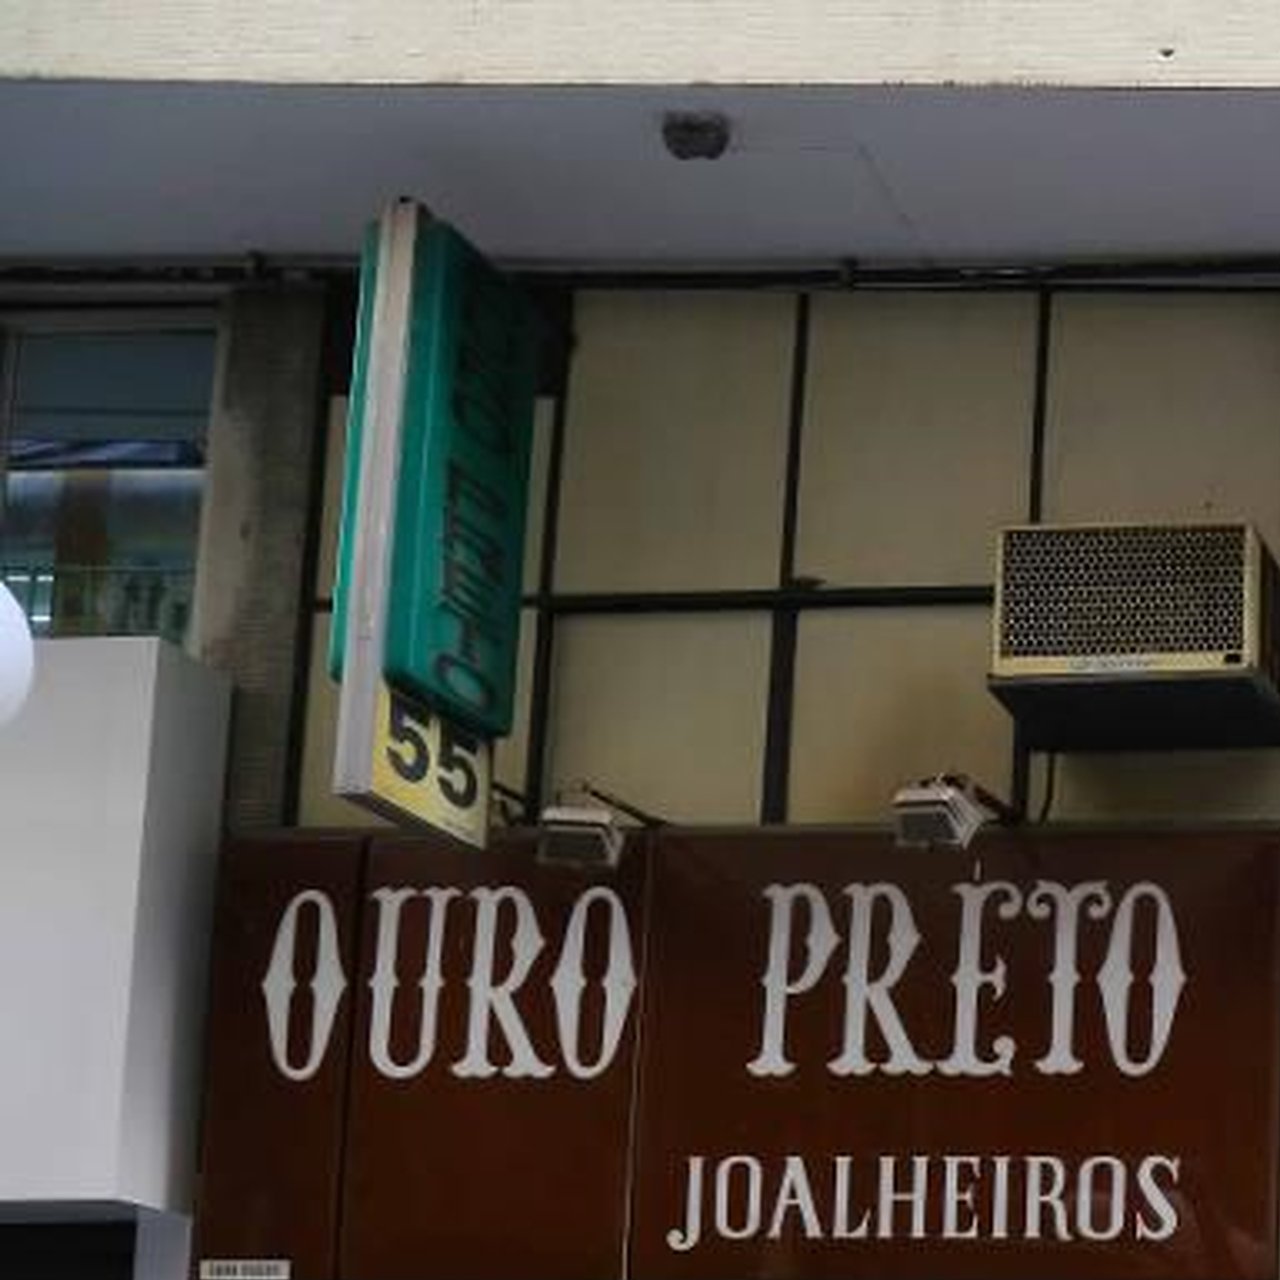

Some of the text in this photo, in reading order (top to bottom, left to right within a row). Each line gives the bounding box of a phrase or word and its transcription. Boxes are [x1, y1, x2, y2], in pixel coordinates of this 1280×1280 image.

[386, 698, 478, 808] 55
[262, 878, 1187, 1081] OURO PRETO
[666, 1155, 1181, 1251] JOALHEIROS
